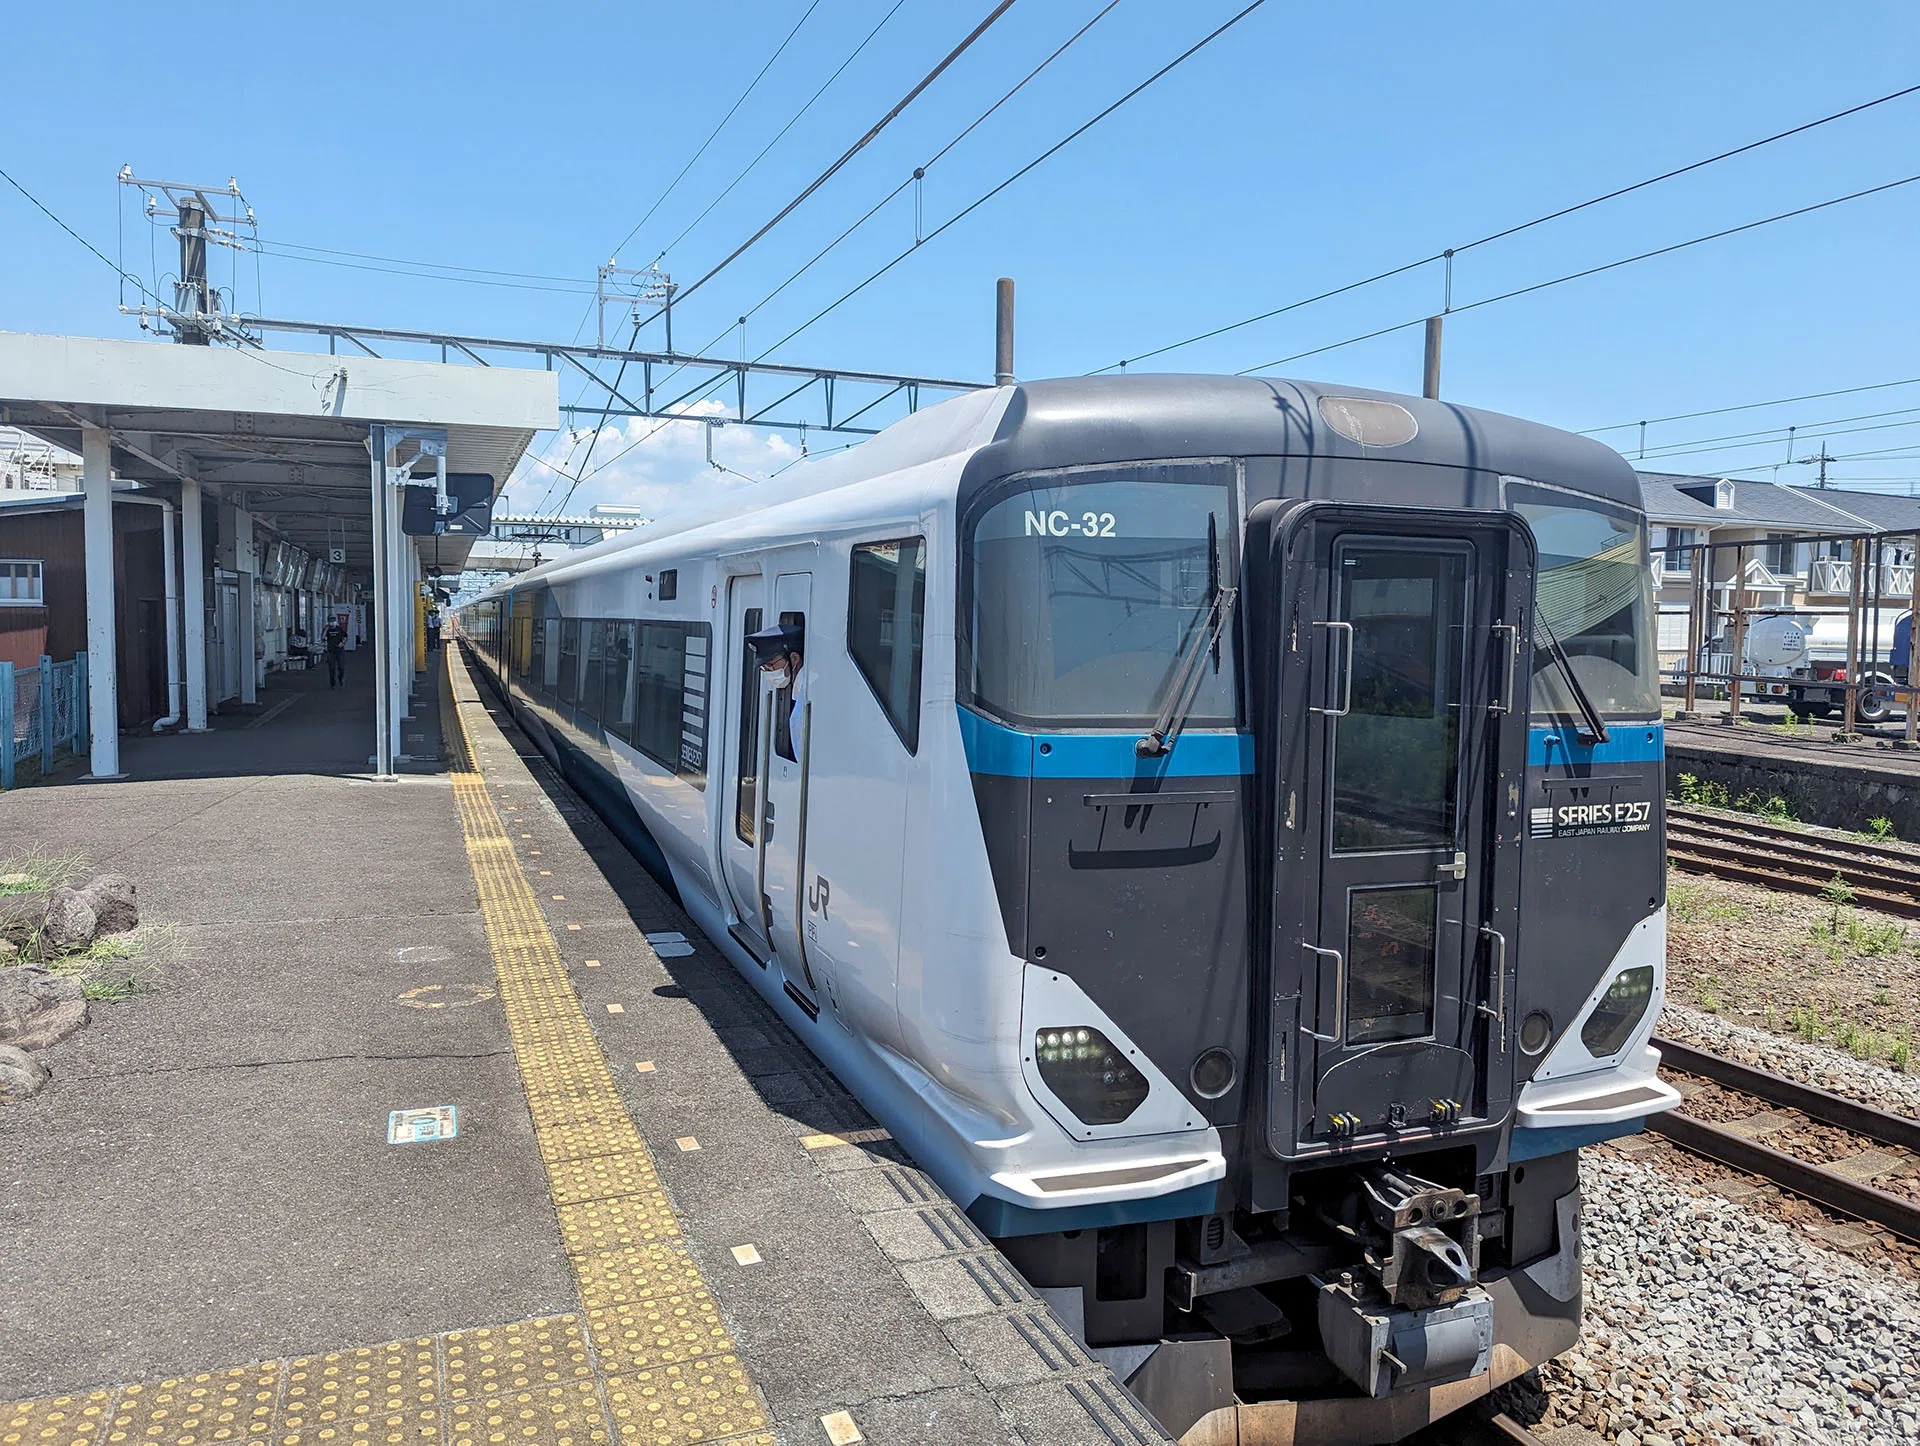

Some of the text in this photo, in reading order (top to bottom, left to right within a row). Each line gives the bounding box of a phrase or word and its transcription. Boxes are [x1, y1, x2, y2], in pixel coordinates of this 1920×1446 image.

[1024, 510, 1117, 538] NC-32
[333, 550, 342, 561] 3
[1558, 801, 1651, 827] SERIES E257
[1558, 823, 1651, 837] EAST JAPAN RAILWAY COMPANY
[808, 874, 830, 921] JR
